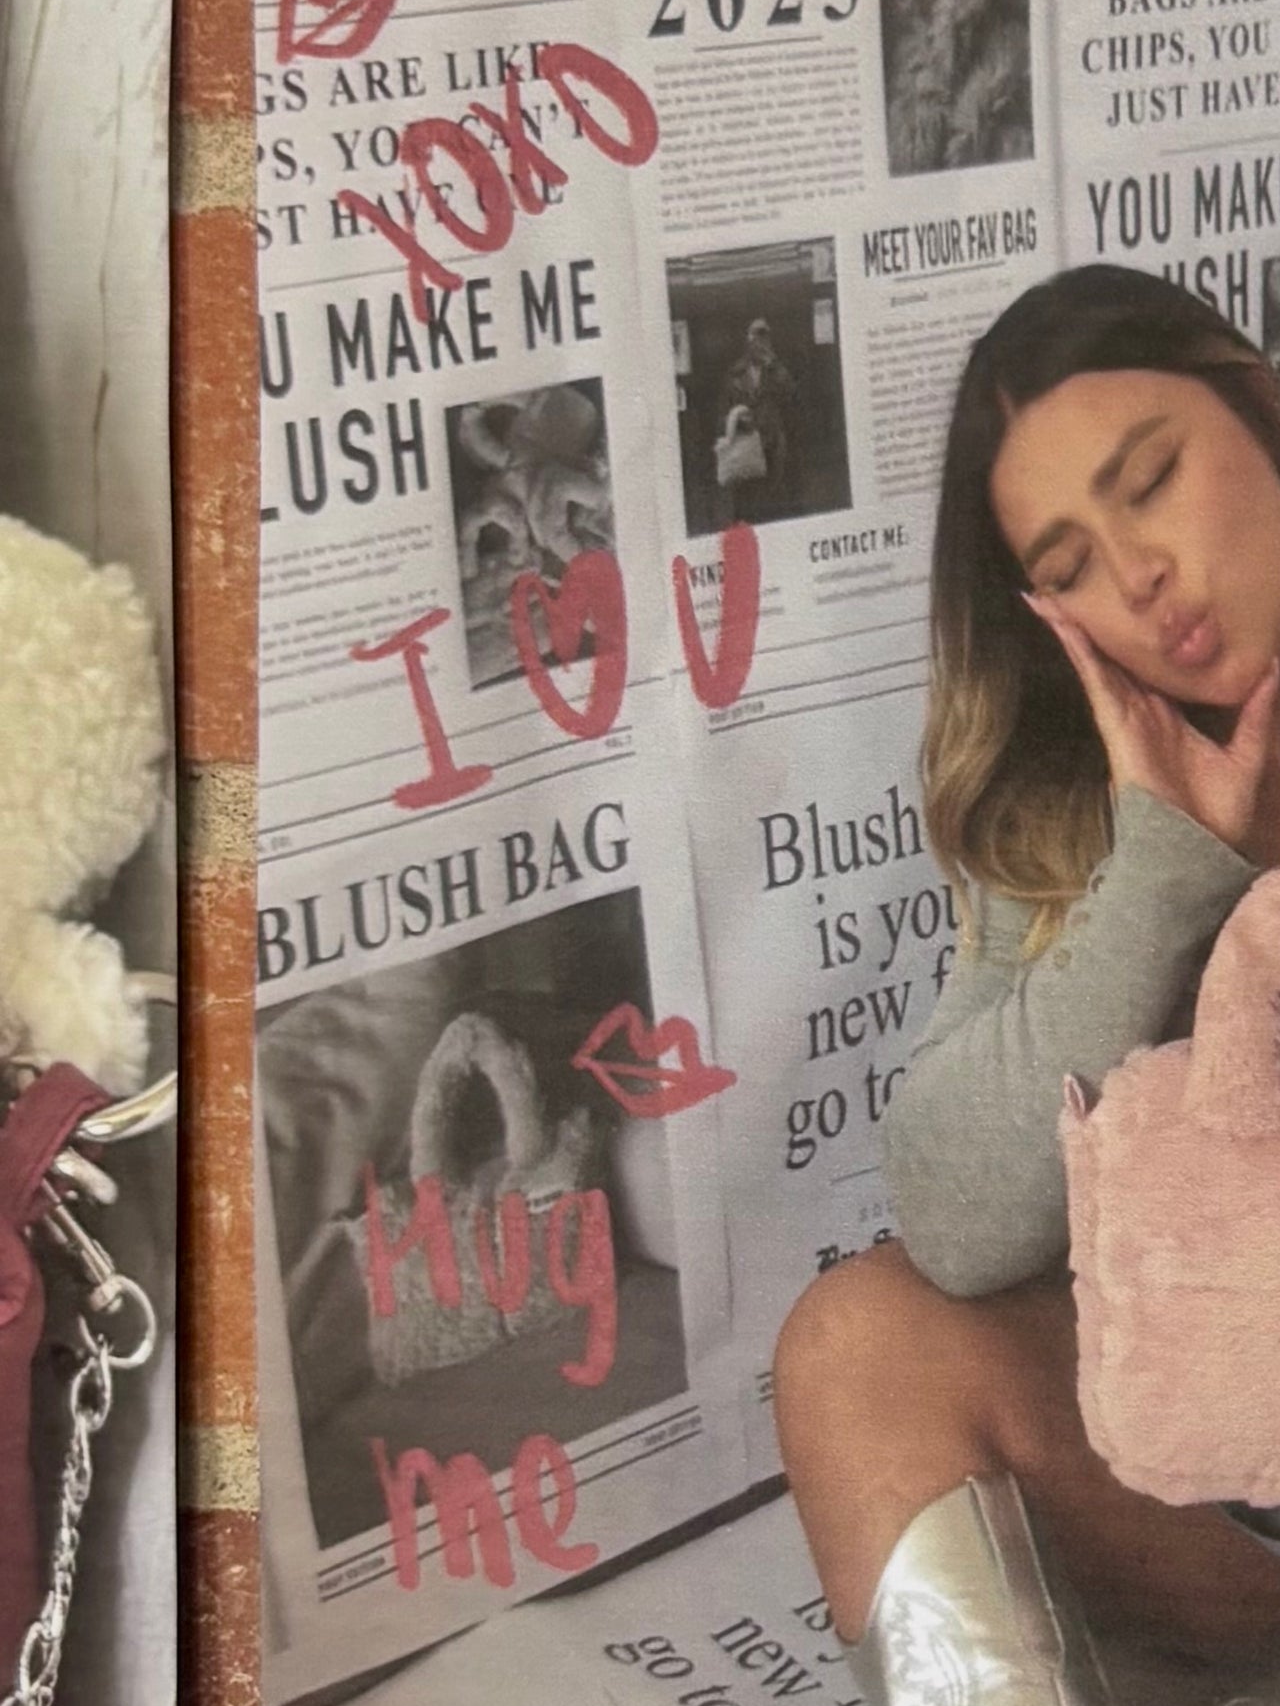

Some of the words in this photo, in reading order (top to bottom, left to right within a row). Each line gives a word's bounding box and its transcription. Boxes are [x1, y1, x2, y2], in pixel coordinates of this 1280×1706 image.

[329, 56, 427, 107] ARE
[446, 40, 553, 92] LIKE
[1208, 22, 1271, 62] YOU
[1105, 84, 1189, 129] JUST
[1200, 71, 1280, 116] HAVE
[863, 235, 912, 280] MEET
[913, 220, 966, 272] YOUR
[965, 214, 1000, 265] FAV
[1000, 206, 1039, 257] BAG
[1086, 171, 1172, 254] YOU
[326, 277, 498, 388] MAKE
[520, 259, 602, 352] ME
[809, 528, 877, 564] CONTACT
[758, 784, 926, 893] Blush
[255, 846, 484, 985] BLUSH
[500, 801, 635, 908] BAG
[815, 893, 862, 971] is
[807, 978, 912, 1062] new
[785, 1095, 848, 1170] go
[367, 1432, 601, 1590] me
[604, 1634, 695, 1680] go
[710, 1616, 824, 1701] new
